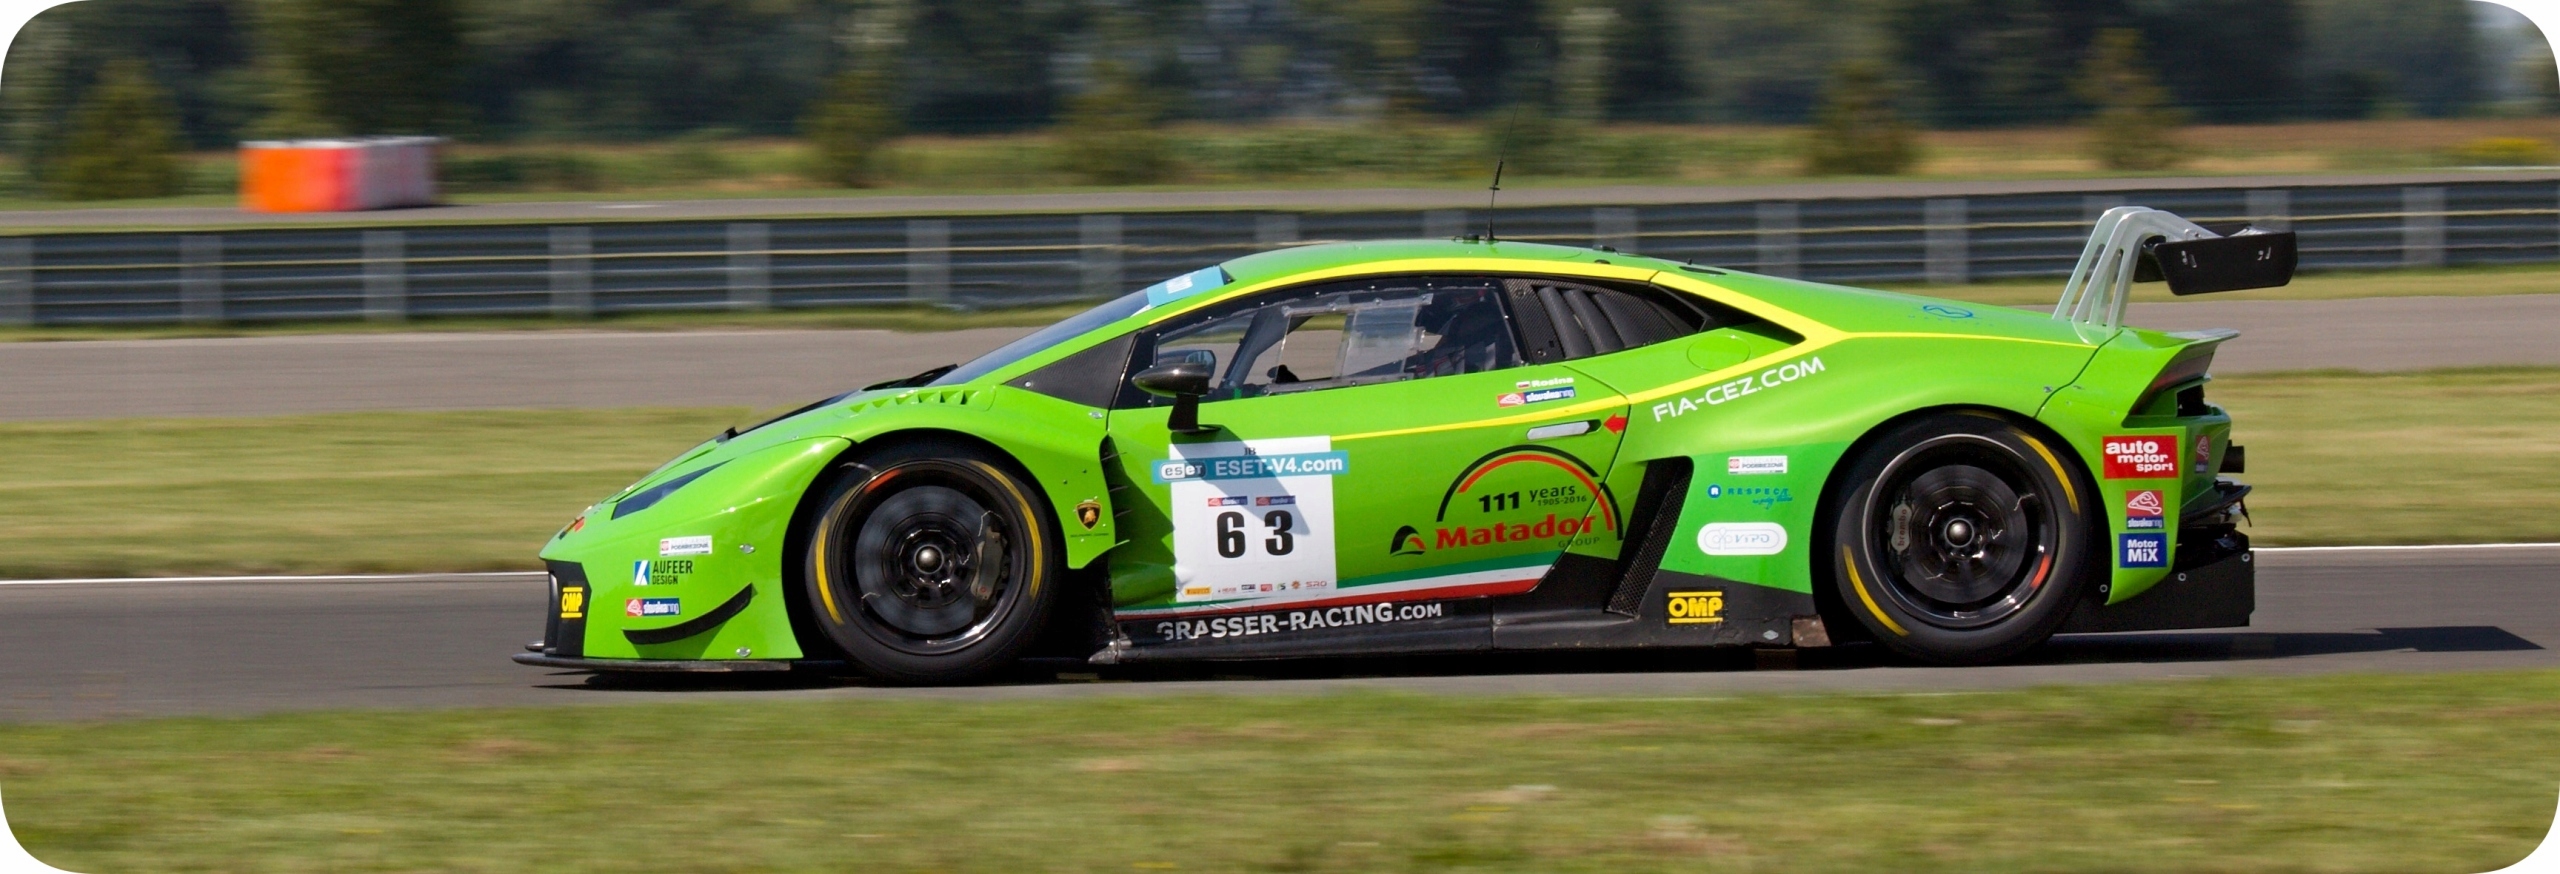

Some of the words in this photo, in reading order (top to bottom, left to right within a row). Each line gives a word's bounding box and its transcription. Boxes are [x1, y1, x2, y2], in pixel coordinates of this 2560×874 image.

[1652, 356, 1826, 422] FIA-CEZ.COM
[2105, 440, 2159, 455] auto
[2117, 454, 2168, 463] motor
[1215, 457, 1343, 476] ESET-V4.com
[2136, 462, 2173, 473] sport
[1479, 491, 1520, 513] 111
[1529, 485, 1576, 502] years
[1537, 495, 1587, 507] 1905-2016
[1436, 514, 1596, 550] Matador
[1558, 537, 1601, 549] GROUP
[2127, 539, 2158, 548] Motor
[2127, 548, 2158, 562] MiX
[652, 560, 693, 574] AUFEER
[652, 575, 678, 585] DESIGN
[562, 592, 583, 612] OMP
[1668, 596, 1723, 618] OMP
